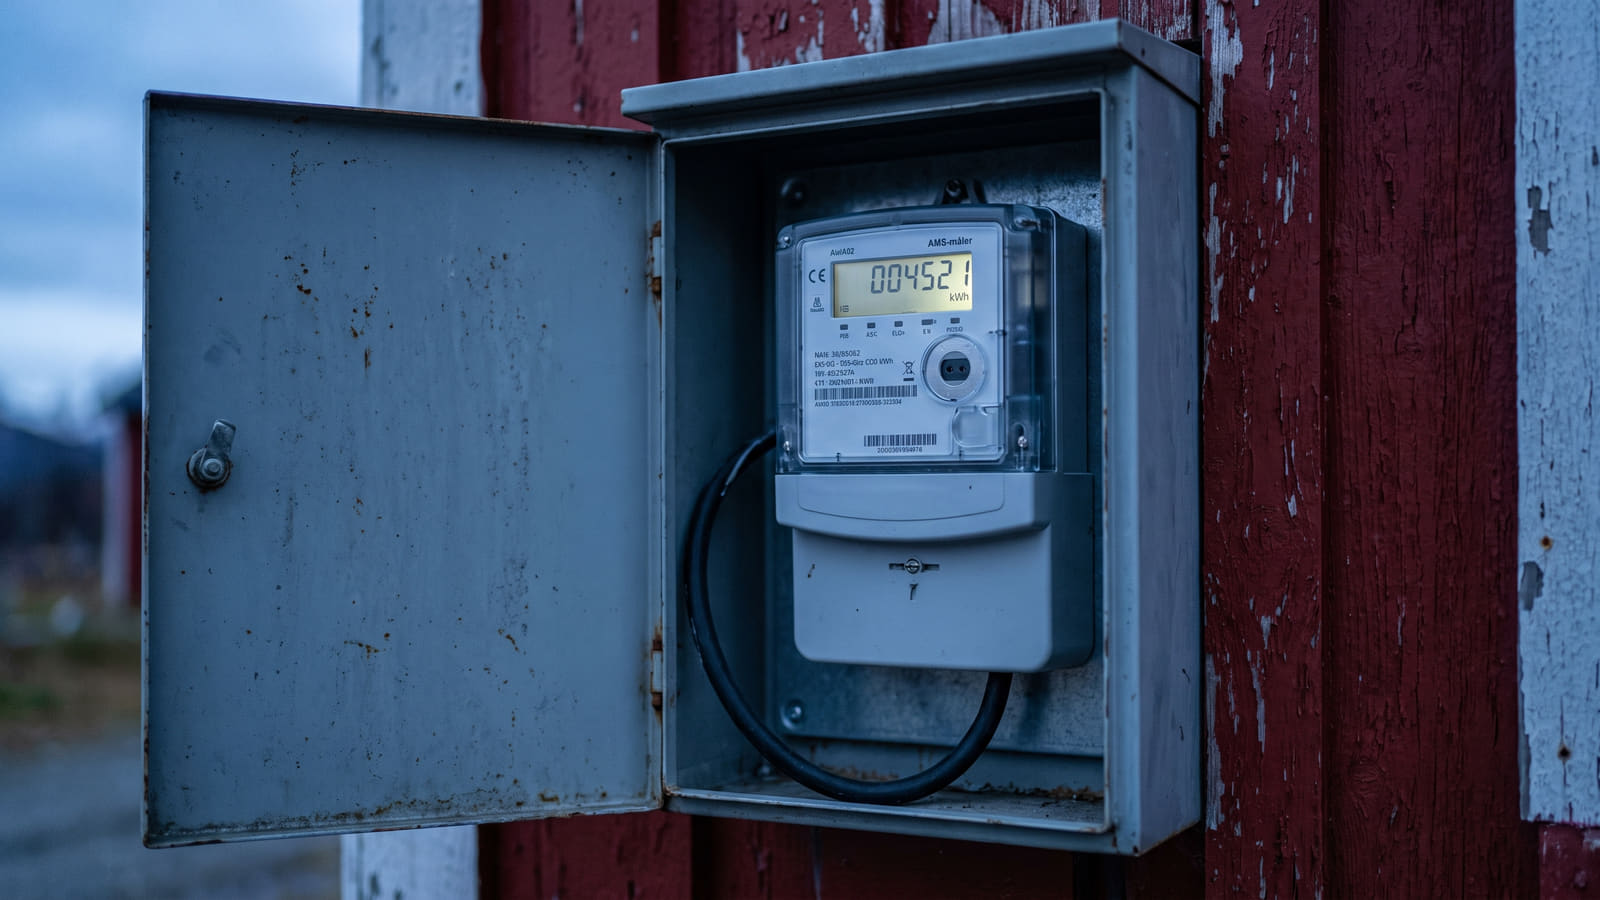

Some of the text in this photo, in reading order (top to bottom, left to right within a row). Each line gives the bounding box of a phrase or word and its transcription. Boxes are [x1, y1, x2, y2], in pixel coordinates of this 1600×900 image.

[927, 237, 973, 248] AMS-måler
[808, 268, 826, 284] CE
[870, 260, 970, 294] 004521
[950, 292, 969, 302] kWh
